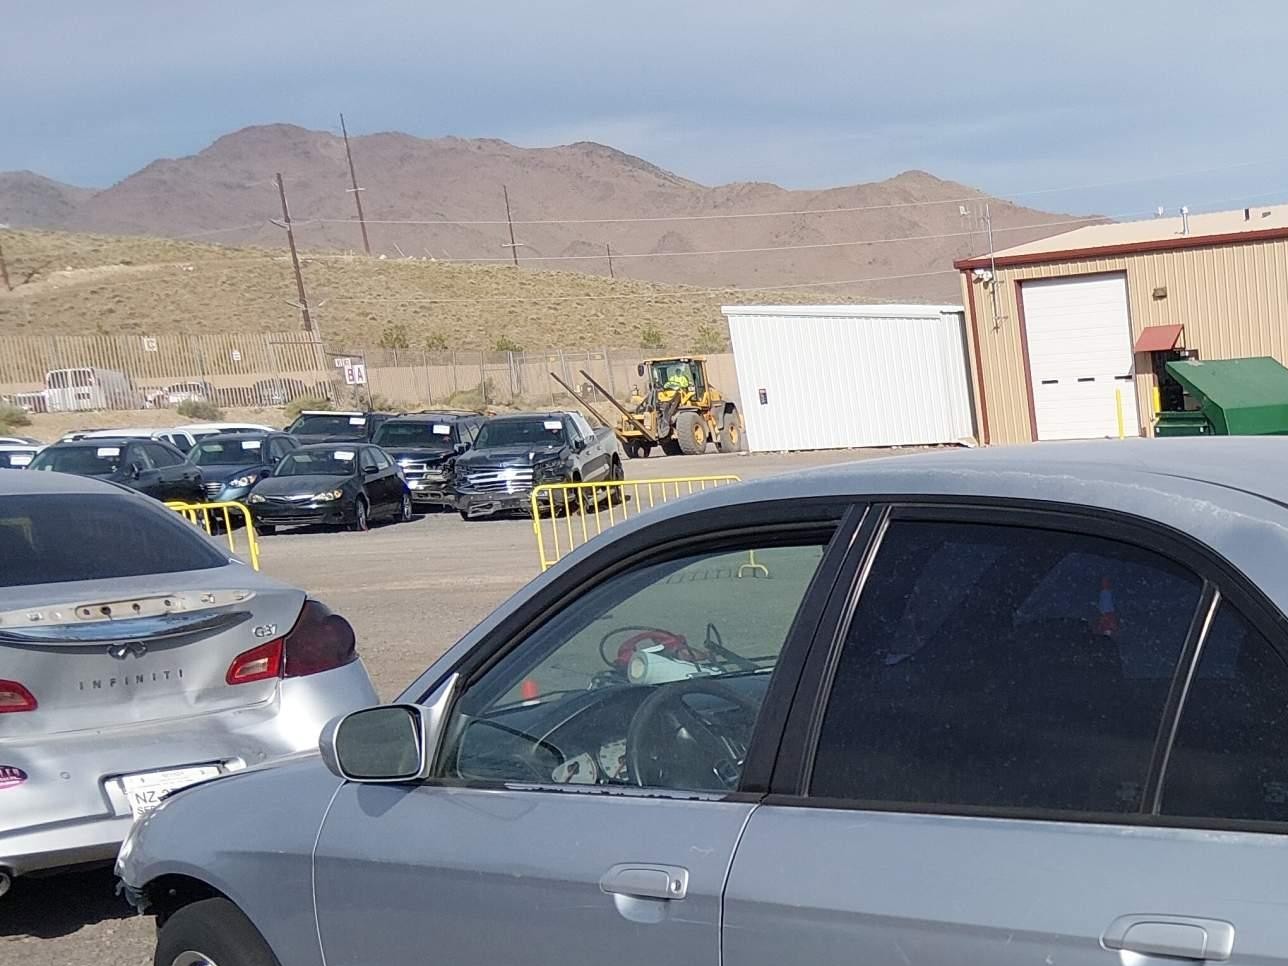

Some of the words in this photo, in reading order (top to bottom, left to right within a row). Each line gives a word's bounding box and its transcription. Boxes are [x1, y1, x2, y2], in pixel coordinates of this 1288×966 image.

[347, 368, 355, 382] B
[357, 367, 364, 382] A
[79, 668, 184, 690] INFINITI
